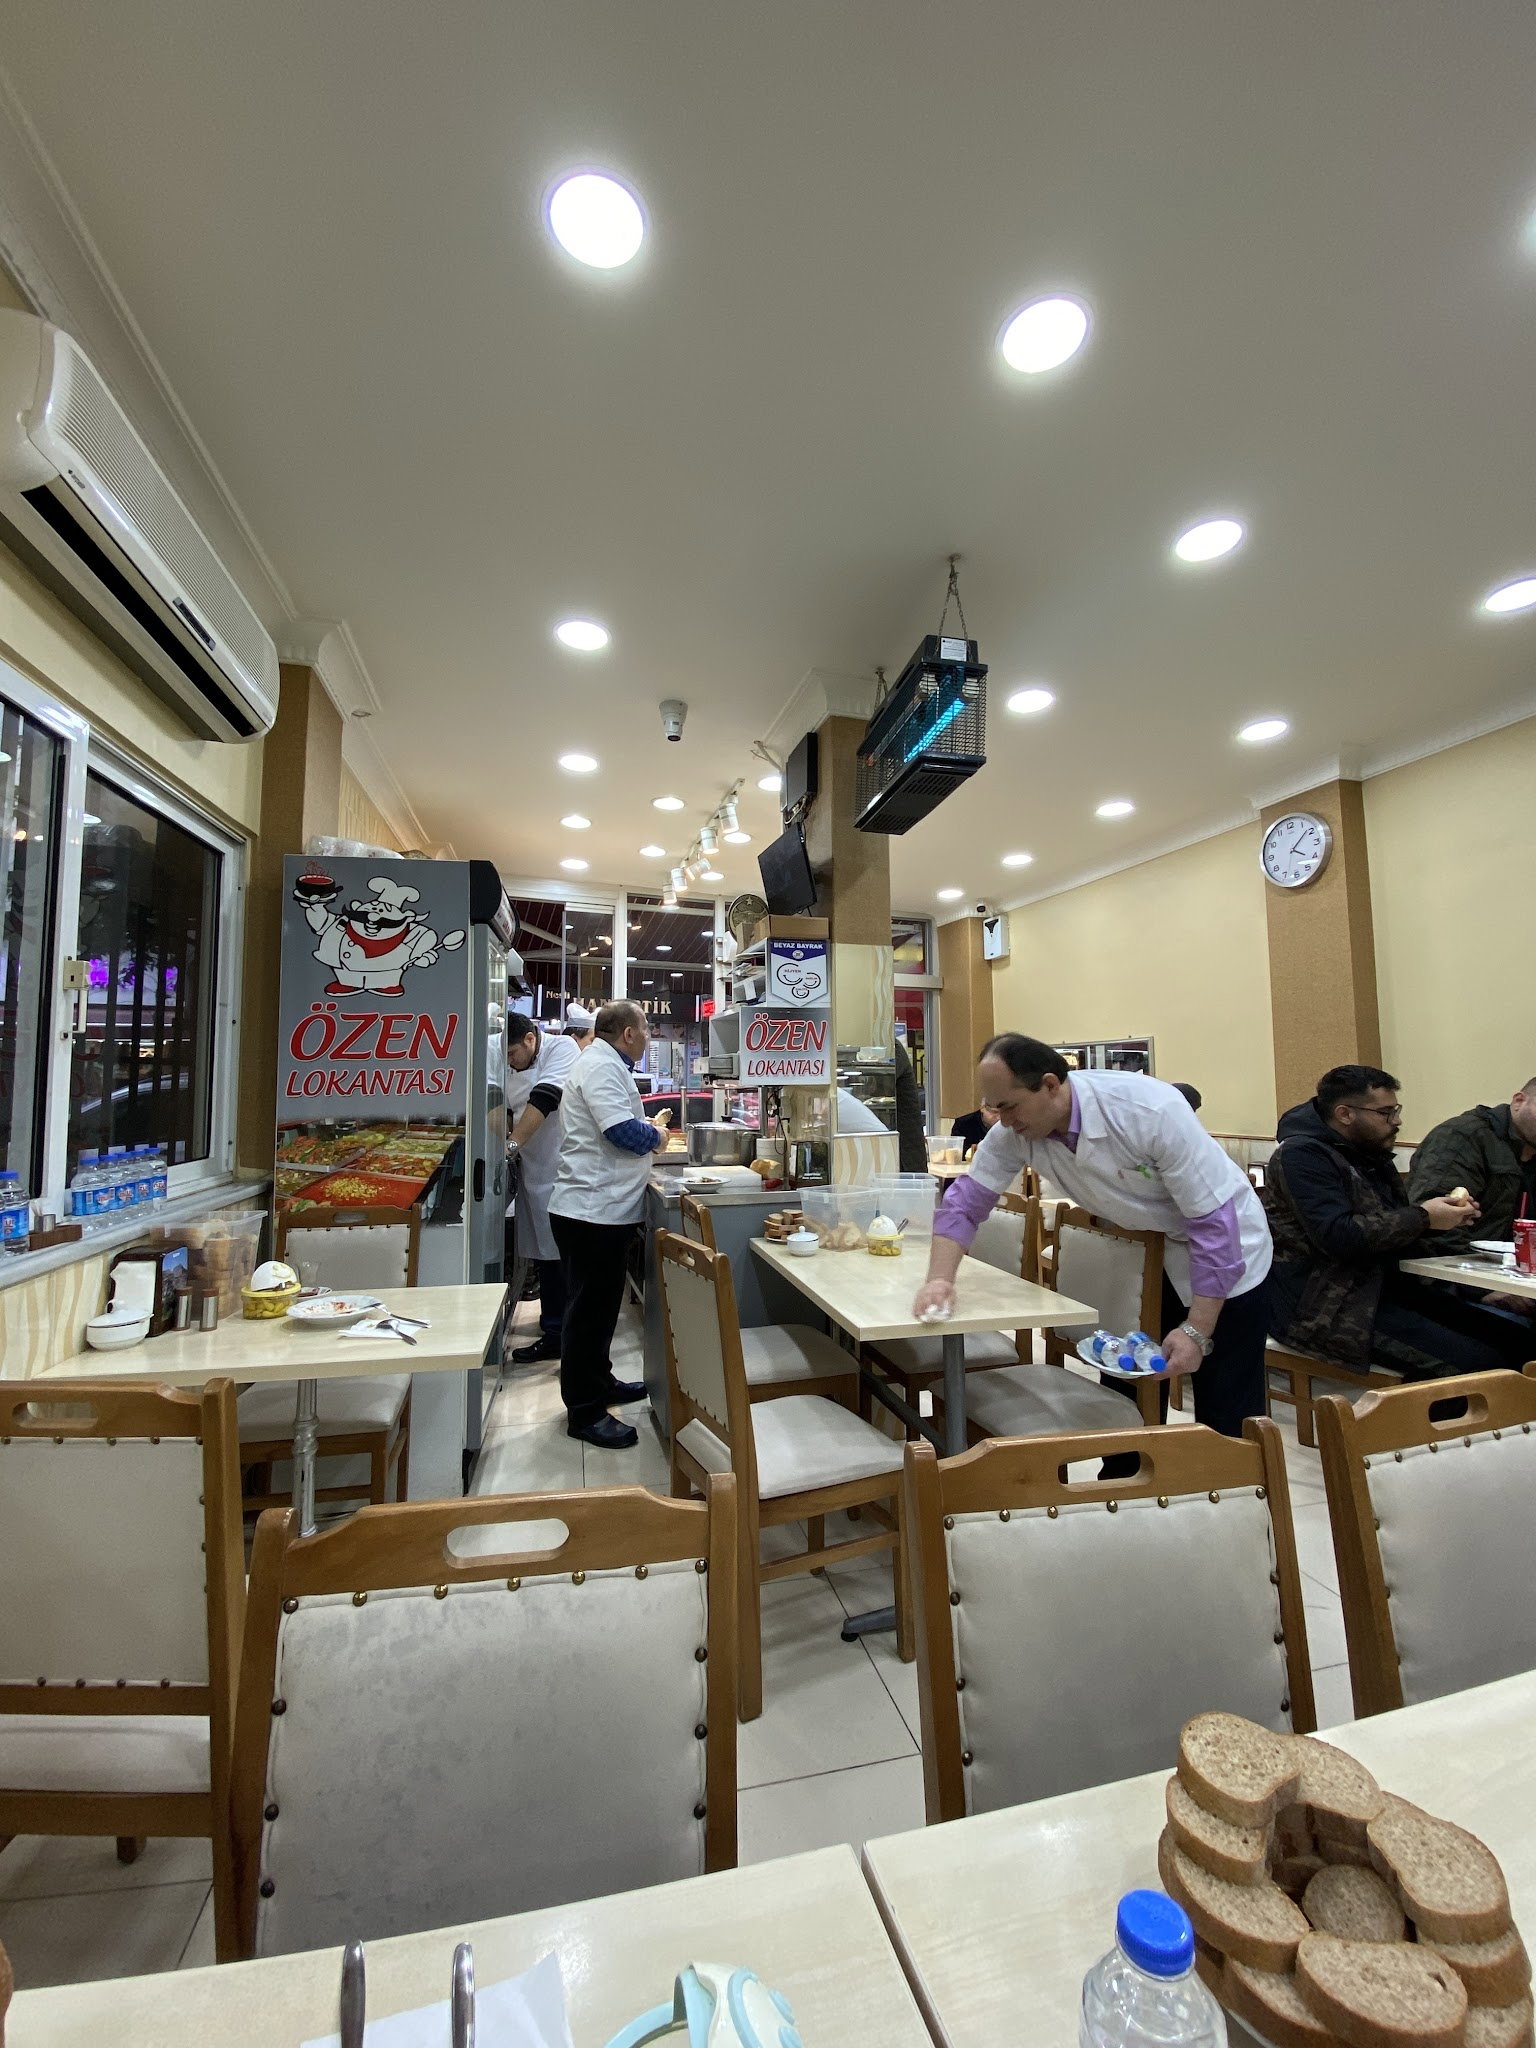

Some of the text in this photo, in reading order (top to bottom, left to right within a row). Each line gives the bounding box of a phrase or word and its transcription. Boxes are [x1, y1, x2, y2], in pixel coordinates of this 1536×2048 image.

[289, 1002, 459, 1062] ÖZEN
[745, 1012, 828, 1053] ÖZEN
[285, 1068, 456, 1098] LOKANTASI
[747, 1058, 825, 1077] LOKANTASI
